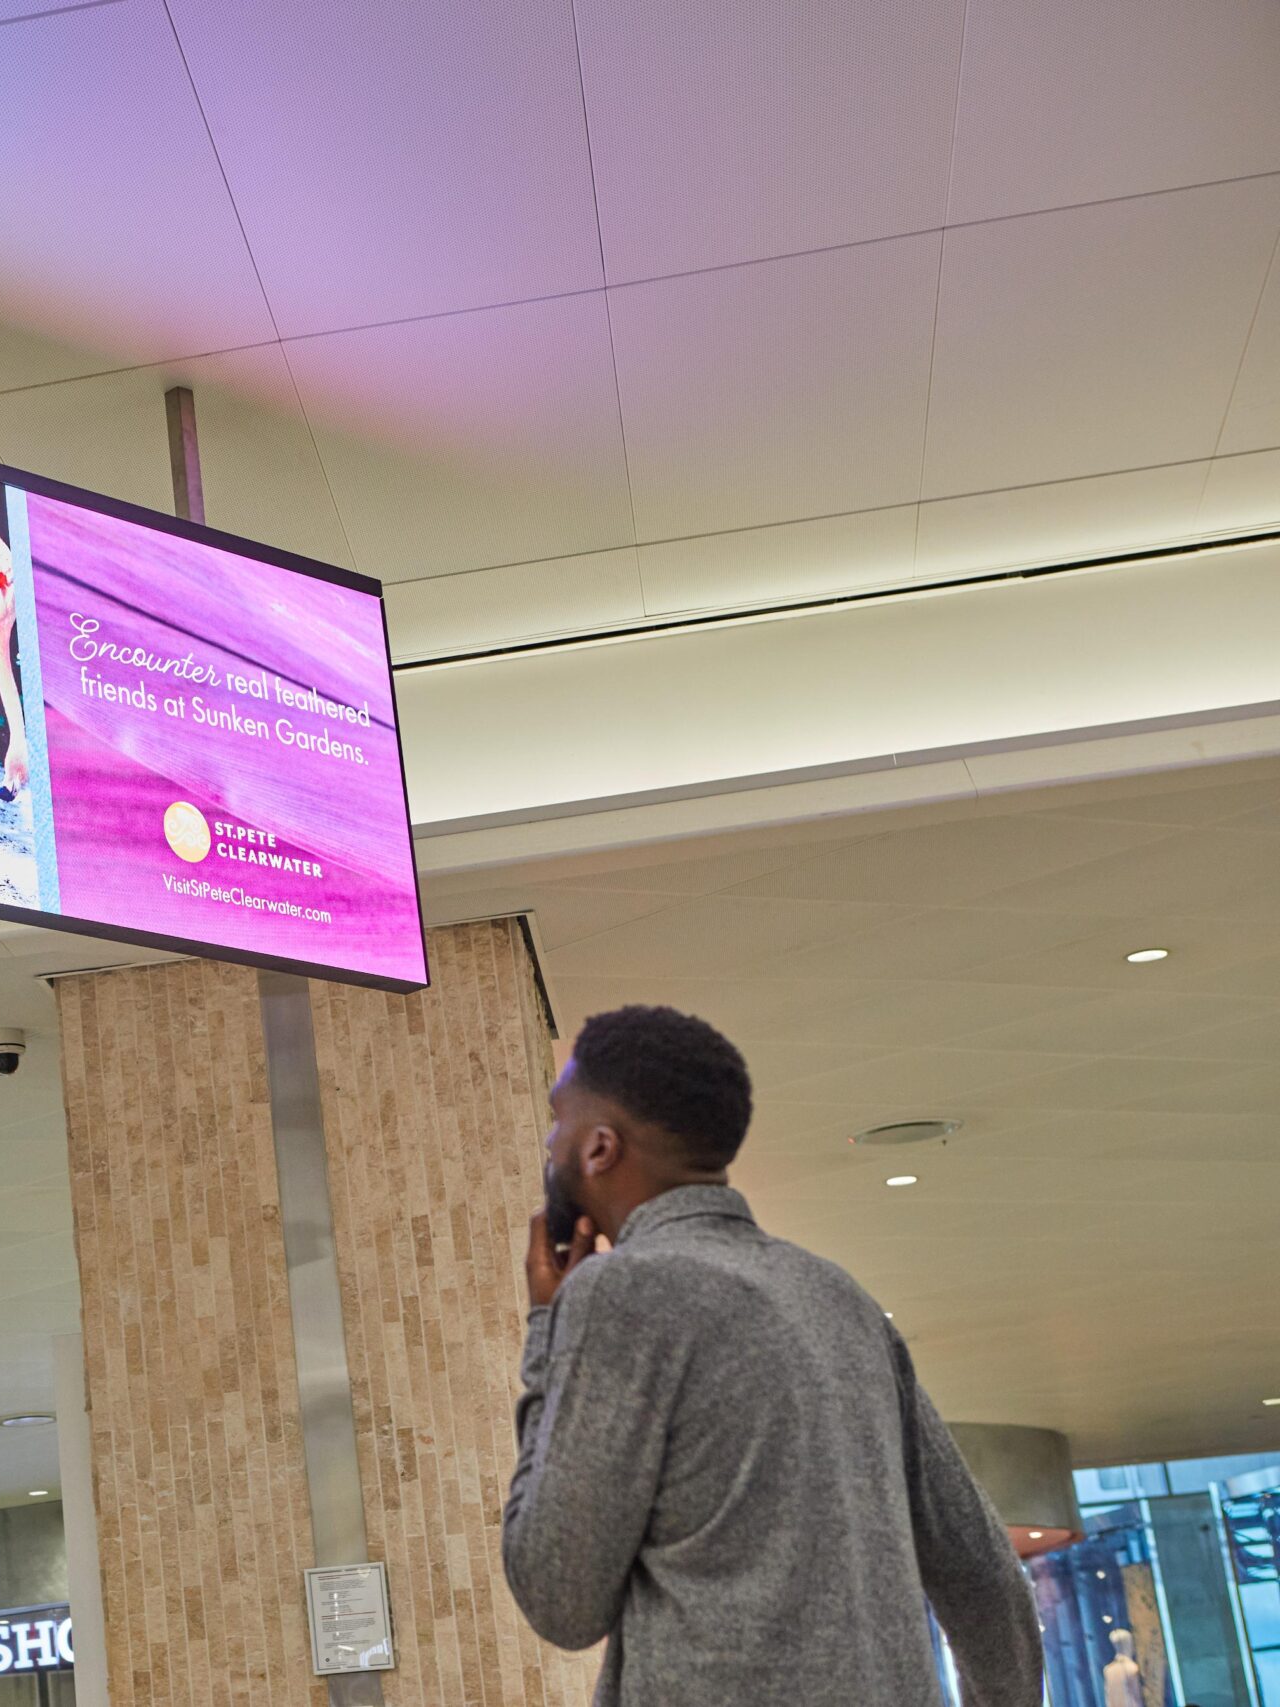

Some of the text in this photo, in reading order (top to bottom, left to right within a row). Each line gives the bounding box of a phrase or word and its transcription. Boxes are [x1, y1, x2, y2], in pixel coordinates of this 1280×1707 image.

[69, 612, 371, 728] Encounter real feathered
[80, 666, 370, 766] friends at Sunken Gardens.
[216, 842, 323, 878] CLEARWATER
[162, 873, 332, 924] VisitStPeteClearwater.com
